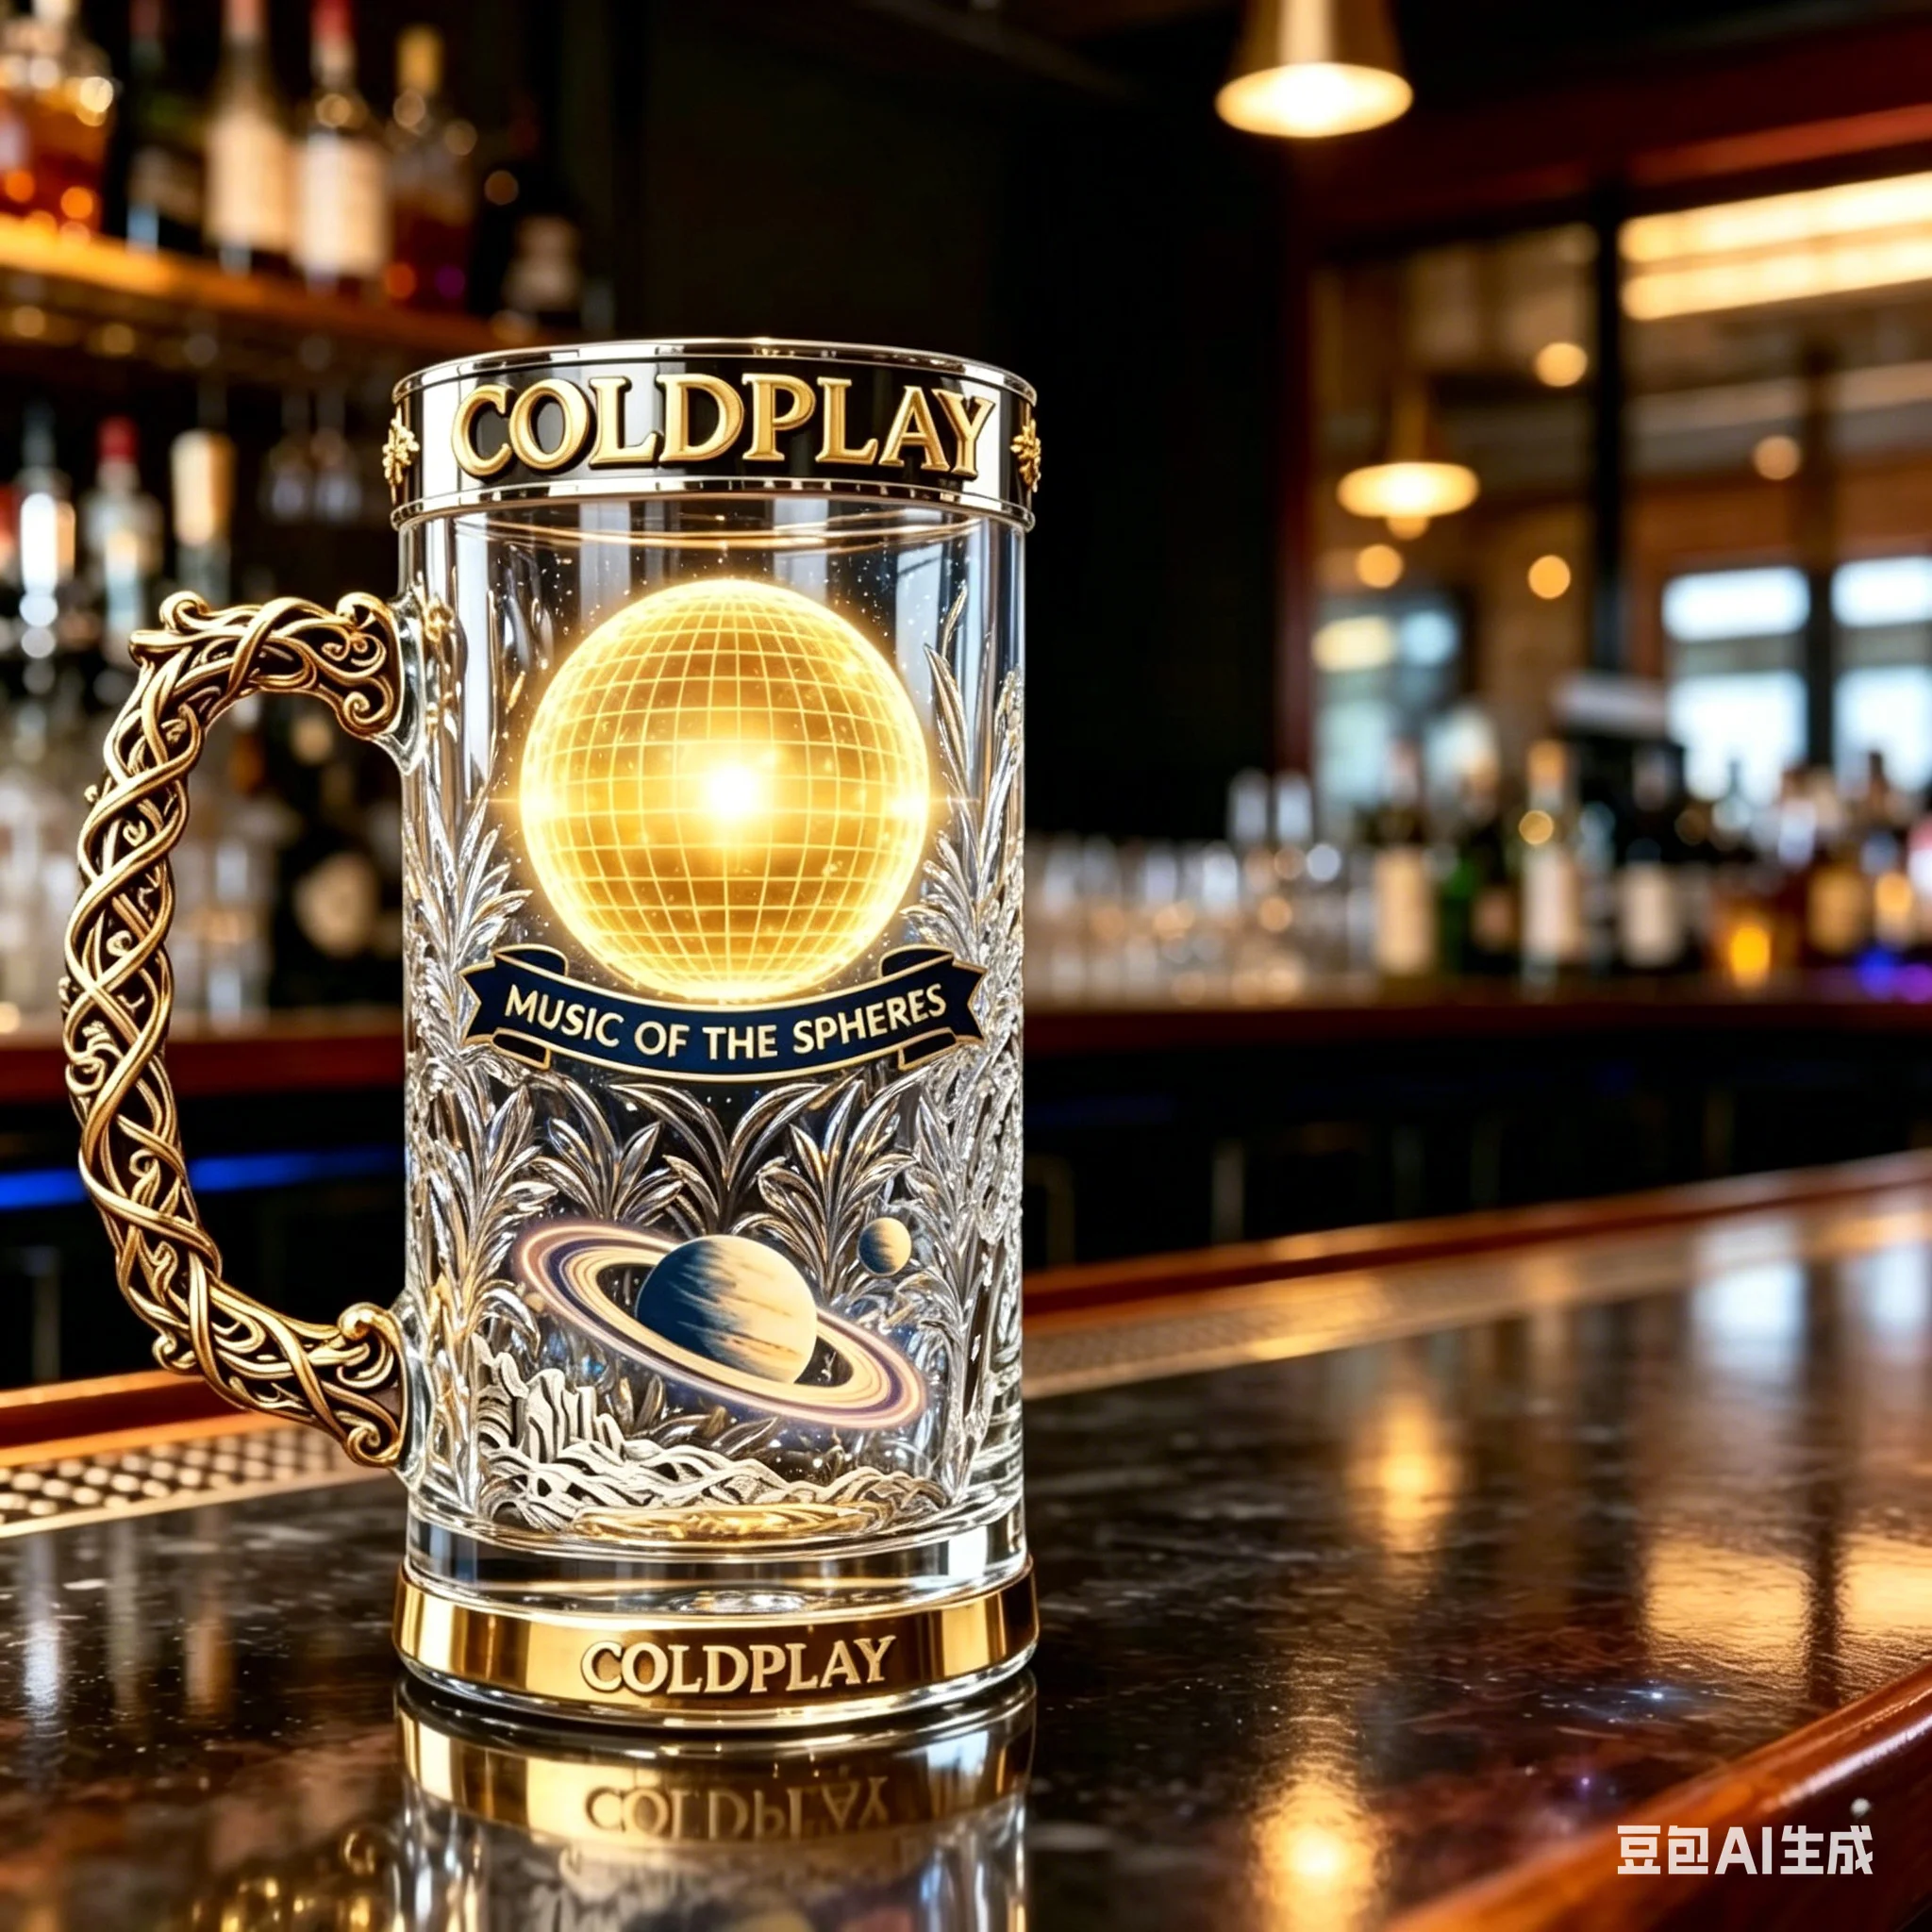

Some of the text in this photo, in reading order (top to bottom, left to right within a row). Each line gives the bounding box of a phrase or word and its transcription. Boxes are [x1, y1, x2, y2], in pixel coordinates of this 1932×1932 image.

[451, 373, 995, 479] COLDPLAY
[505, 983, 947, 1059] MUSIC OF THE SPHERES
[580, 1635, 896, 1694] COLDPLAY
